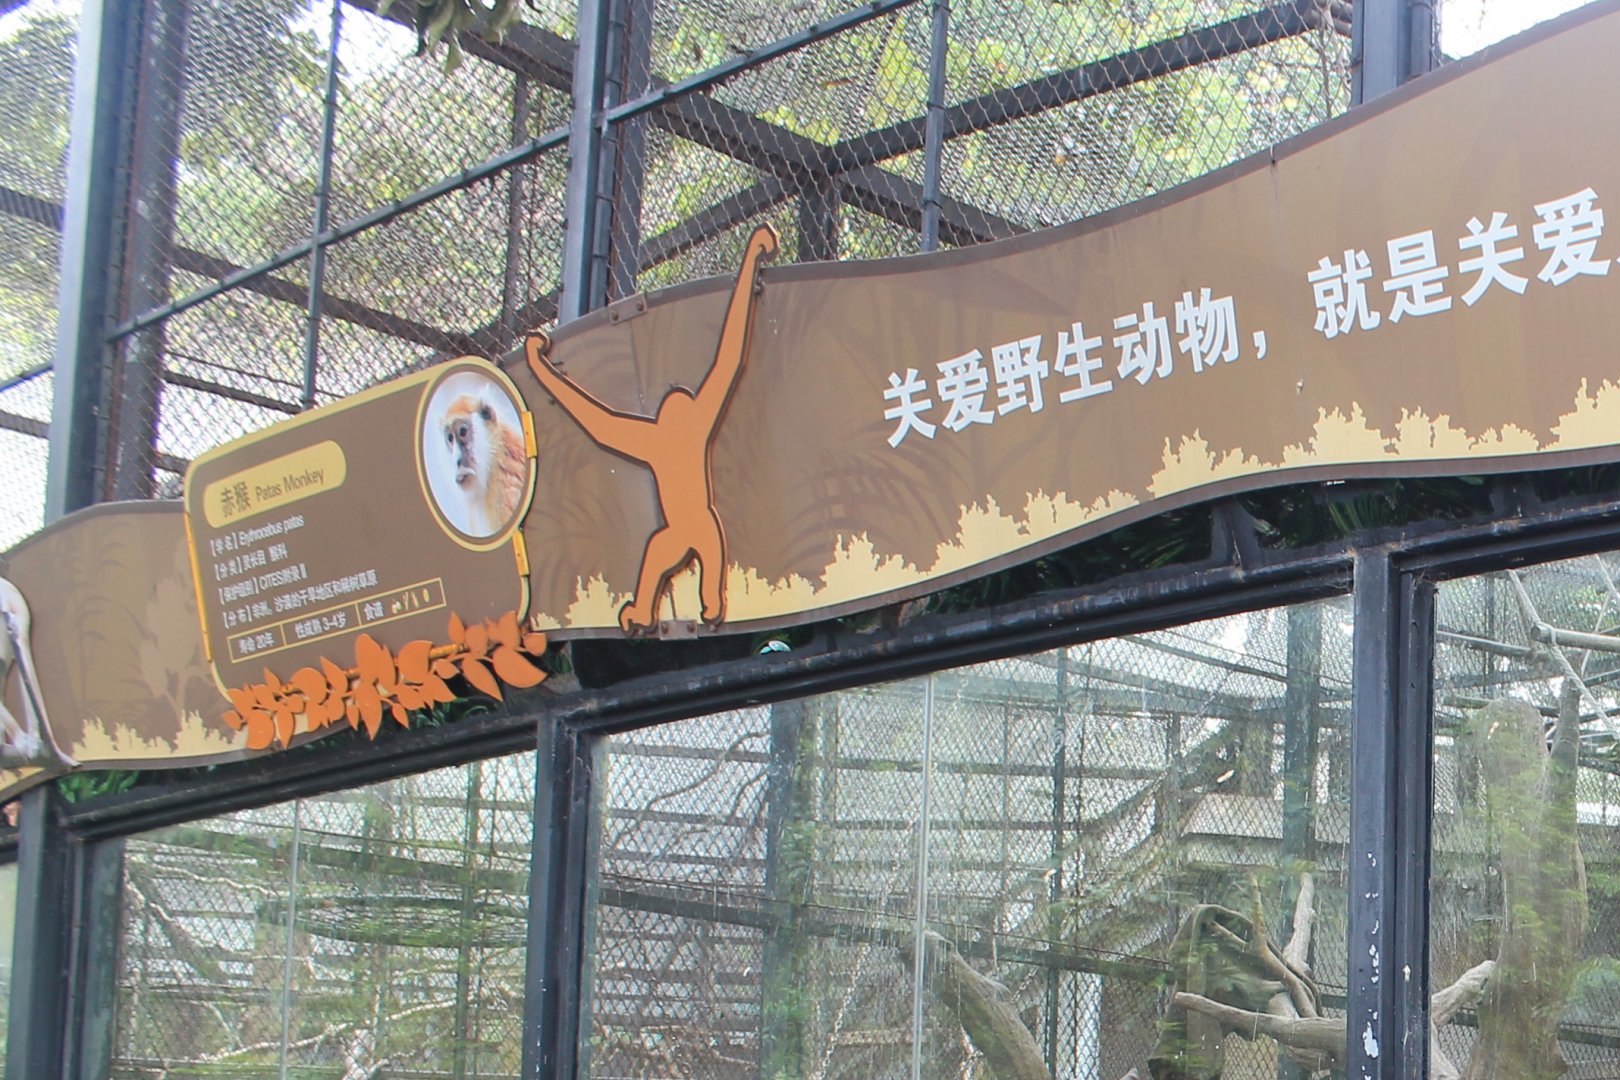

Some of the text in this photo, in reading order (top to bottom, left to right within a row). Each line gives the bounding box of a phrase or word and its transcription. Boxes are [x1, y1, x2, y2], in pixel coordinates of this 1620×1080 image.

[220, 468, 324, 518] 赤猴 Patas Monkey
